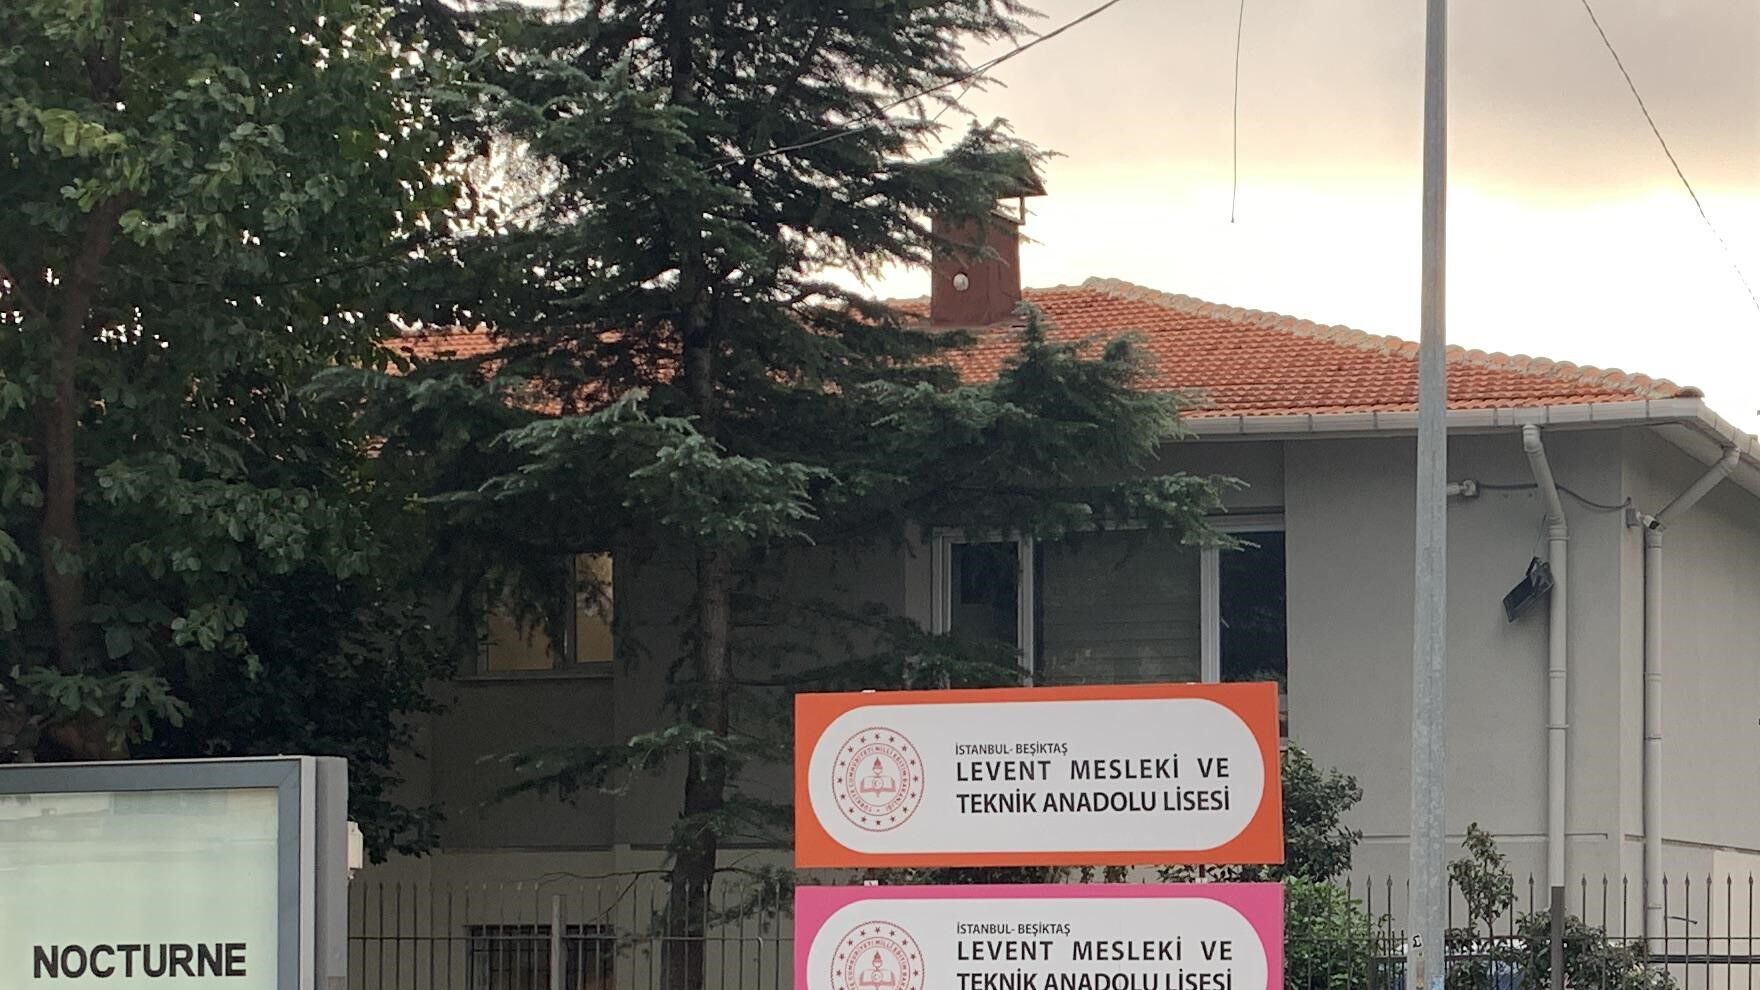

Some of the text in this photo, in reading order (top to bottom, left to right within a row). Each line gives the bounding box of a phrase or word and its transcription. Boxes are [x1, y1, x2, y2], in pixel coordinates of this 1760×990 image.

[955, 741, 1068, 756] İSTANBUL- BEŞİKTAŞ
[957, 753, 1229, 781] LEVENT MESLEKİ VE
[956, 785, 1229, 813] TEKNİK ANADOLU LİSESİ
[957, 921, 1070, 936] İSTANBUL- BEŞİKTAŞ
[33, 943, 247, 978] NOCTURNE
[958, 936, 1233, 961] LEVENT MESLEKİ VE
